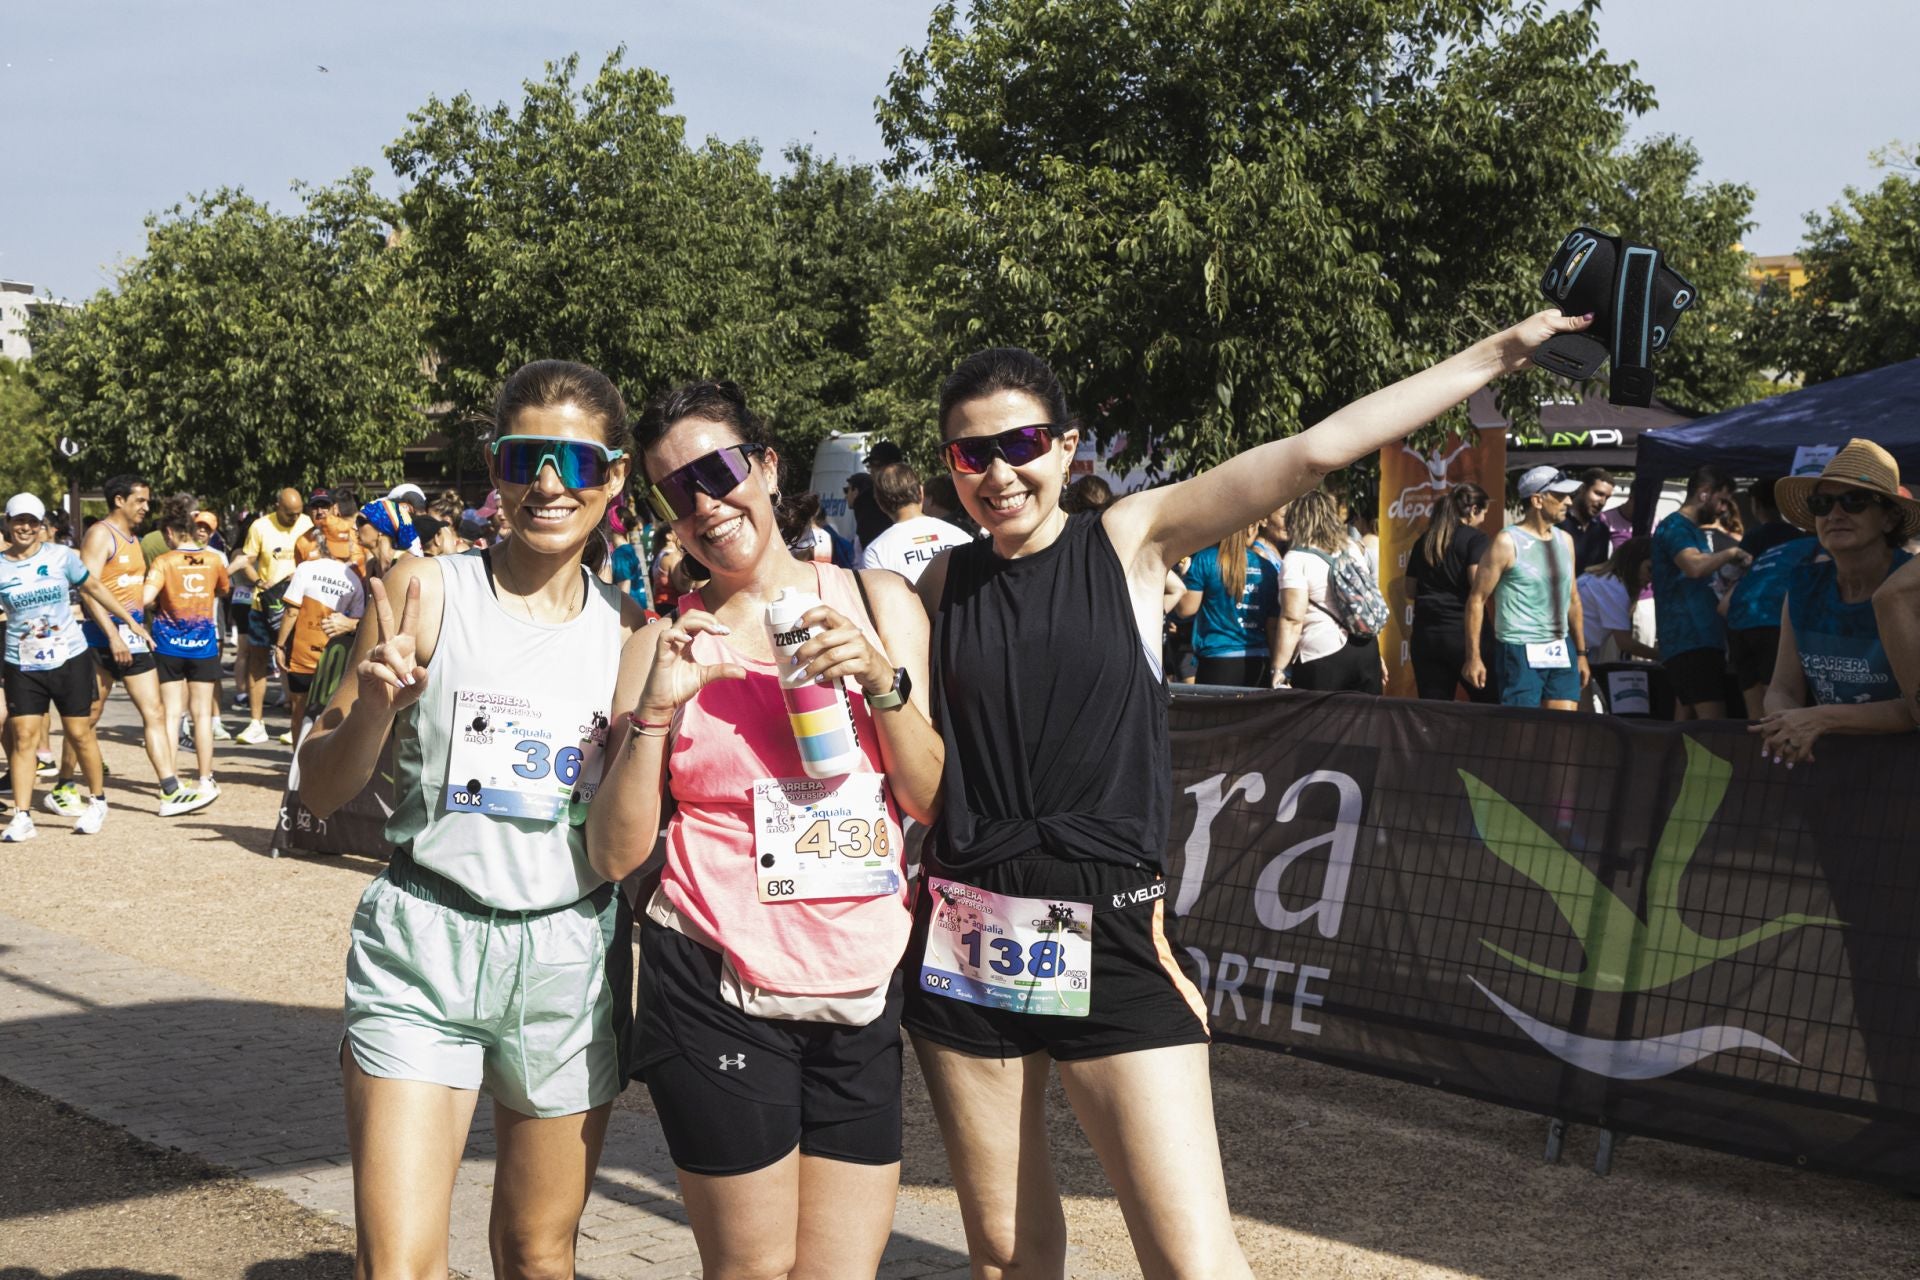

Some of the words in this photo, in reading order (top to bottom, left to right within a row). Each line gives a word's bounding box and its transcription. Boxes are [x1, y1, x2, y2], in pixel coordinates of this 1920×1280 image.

[321, 585, 344, 597] ELVAS
[14, 592, 62, 608] ROMANAS
[773, 628, 811, 648] 226ERS
[34, 648, 54, 661] 41
[1810, 655, 1870, 673] CARRERA
[1829, 671, 1889, 684] DIVERSIDAD
[475, 692, 531, 709] CARRERA
[511, 727, 552, 740] aqualia
[512, 739, 585, 786] 36
[453, 792, 469, 805] 10
[470, 794, 482, 807] K
[811, 807, 852, 820] aqualia
[795, 817, 890, 859] 438
[767, 880, 795, 897] 5K
[942, 884, 984, 904] CARRERA
[972, 919, 1004, 935] aqualia
[961, 930, 1066, 979] 138
[926, 974, 939, 987] 10
[940, 977, 951, 990] K
[1069, 977, 1088, 990] 01
